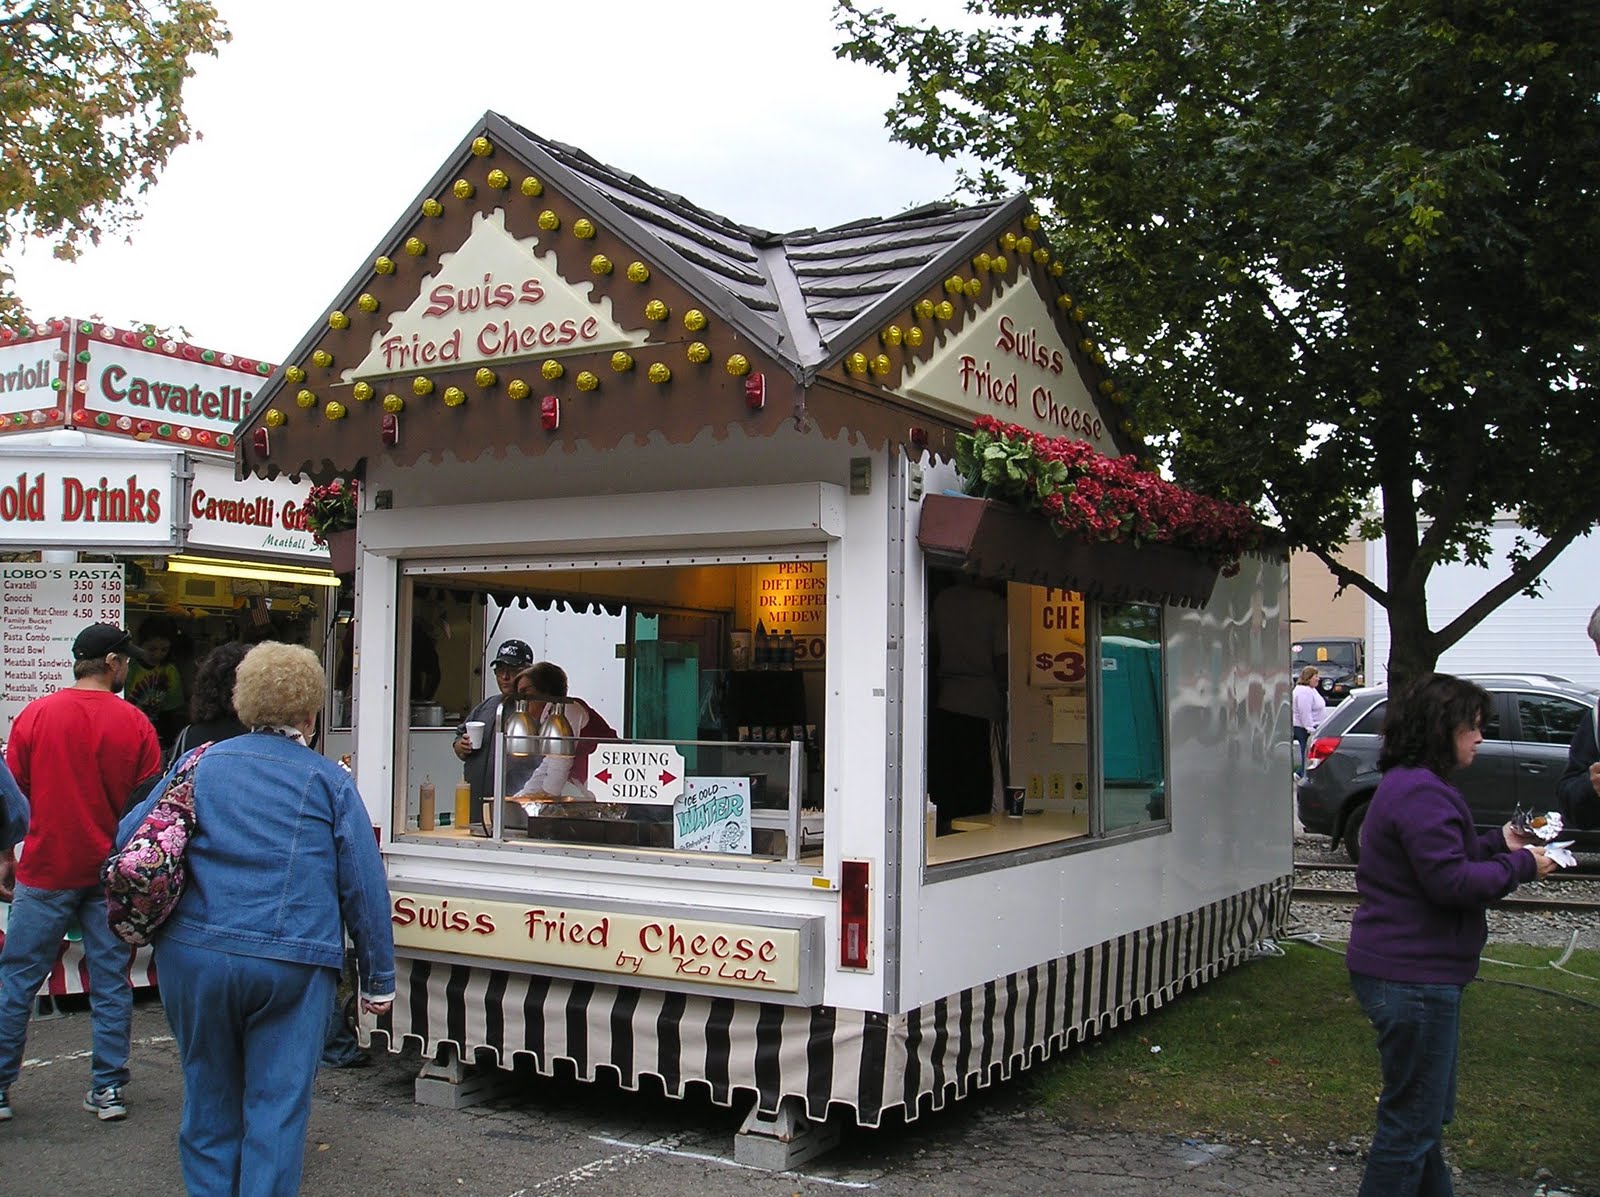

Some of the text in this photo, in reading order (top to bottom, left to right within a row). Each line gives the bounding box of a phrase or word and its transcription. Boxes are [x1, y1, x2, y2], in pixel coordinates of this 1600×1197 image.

[422, 273, 545, 318] Swiss
[381, 316, 598, 369] Fried Cheese
[997, 316, 1063, 375] Swiss
[101, 364, 253, 423] Cavatelli
[959, 355, 1101, 440] Fried Cheese
[62, 474, 160, 523] Drinks
[191, 489, 274, 528] Cavatelli
[262, 534, 305, 549] Meatball
[3, 570, 122, 579] LOBO'S PASTA
[779, 562, 813, 574] PEPSI
[4, 581, 121, 591] Cavatelli 3.50 4.50
[762, 577, 826, 591] DIET PEPS
[4, 593, 121, 604] Gnocchi 4.00 5.00
[760, 595, 781, 606] DR.
[4, 606, 29, 615] Ravioli
[73, 609, 93, 618] 4.50
[101, 609, 120, 619] 5.50
[769, 610, 821, 622] MT DEW
[1043, 606, 1080, 629] CHE
[4, 617, 25, 625] Family
[4, 632, 22, 641] Pasta
[26, 632, 50, 641] Combo
[4, 645, 45, 654] Bread Bowl
[4, 658, 72, 667] Meatball Sandwich
[5, 671, 62, 681] Meatball Splash
[5, 683, 38, 692] Meatballs
[42, 683, 56, 693] .50
[602, 752, 669, 766] SERVING
[624, 768, 646, 782] ON
[612, 784, 658, 798] SIDES
[684, 784, 719, 806] ICE COLD
[676, 794, 744, 837] WATER
[391, 897, 778, 962] Swiss Fried Cheese
[615, 950, 777, 983] by Kolar
